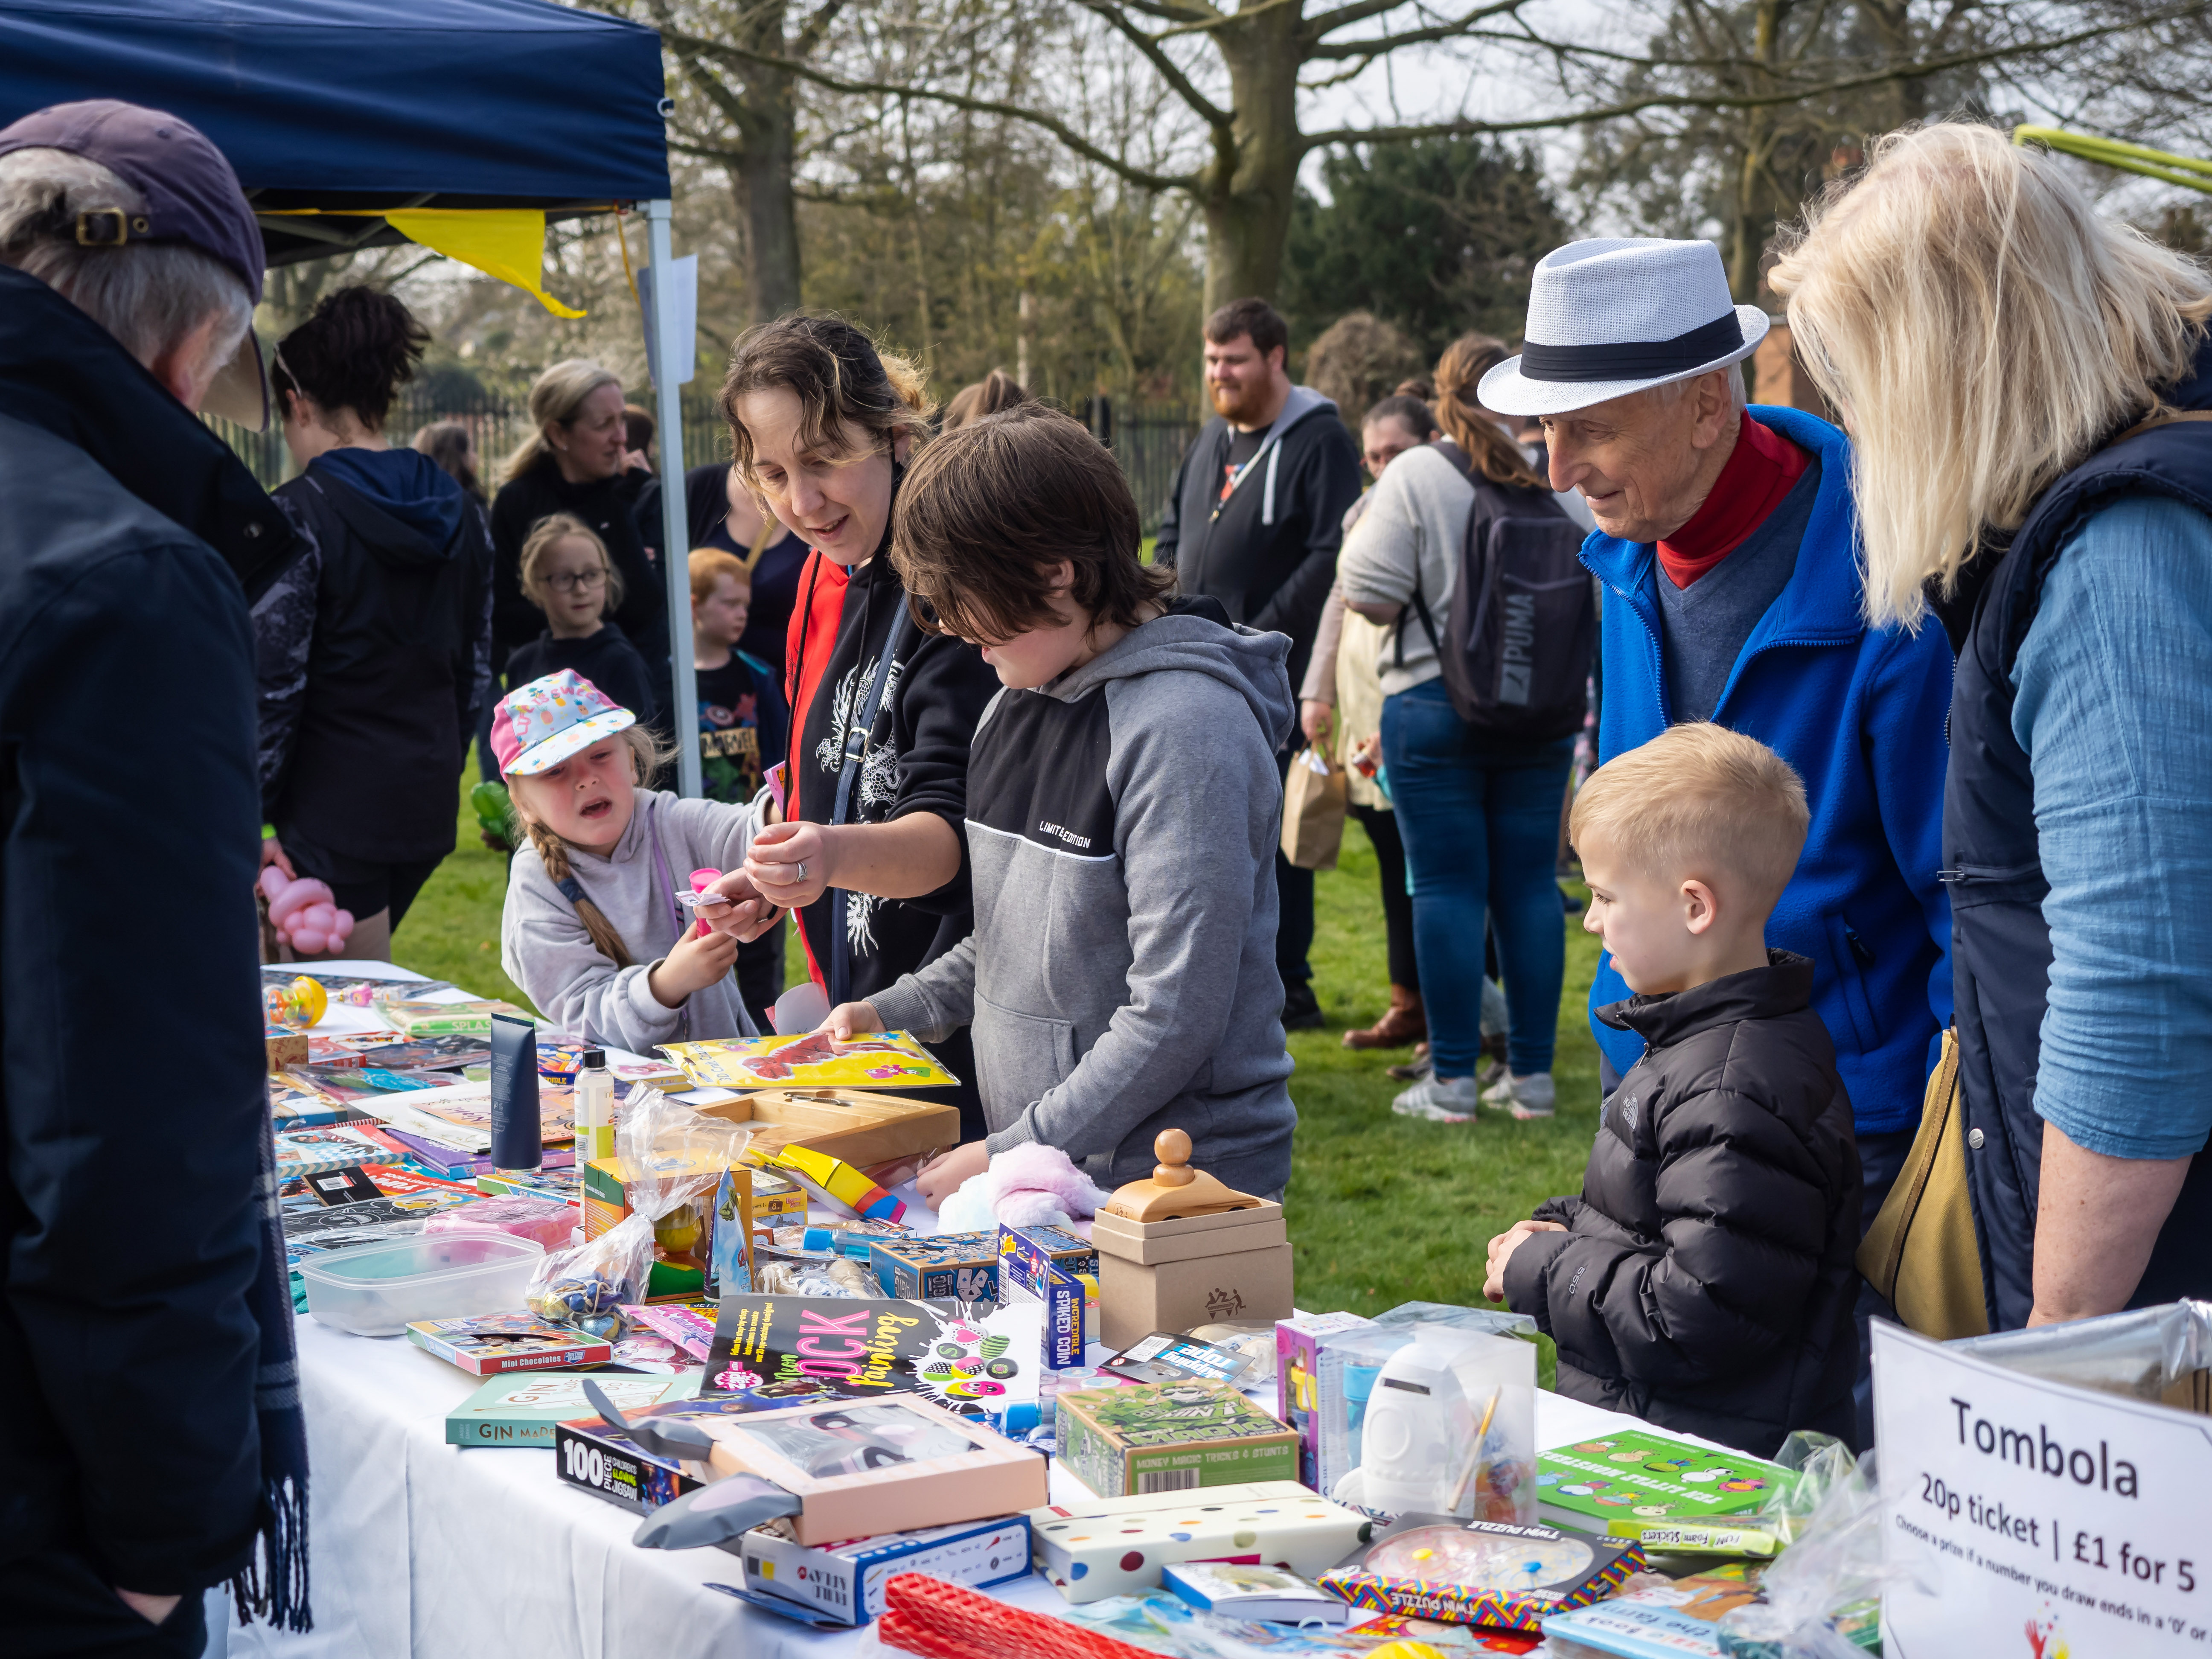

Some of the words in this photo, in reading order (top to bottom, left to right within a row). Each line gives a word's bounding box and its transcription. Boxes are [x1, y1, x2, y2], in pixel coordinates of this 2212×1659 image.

[1502, 594, 1535, 660] PUMA
[1062, 830, 1091, 848] EDITION
[452, 1021, 491, 1031] SPLAS
[542, 1157, 557, 1166] Olds
[933, 1275, 947, 1296] GIC
[1056, 1289, 1071, 1334] SPIKED
[1069, 1297, 1080, 1355] INCREDIBLE
[796, 1309, 870, 1381] OCK
[1056, 1336, 1071, 1365] COIN
[501, 1359, 518, 1368] Mini
[519, 1354, 562, 1367] Chocolates
[507, 1384, 559, 1403] GIN
[479, 1423, 513, 1441] GIN
[520, 1427, 556, 1439] MADE
[1123, 1420, 1278, 1447] MAGIC
[1136, 1455, 1170, 1469] MONEY
[1172, 1453, 1202, 1467] MAGIC
[1205, 1450, 1239, 1462] TRICKS
[1252, 1445, 1289, 1458] STUNTS
[1950, 1396, 2139, 1500] Tombola
[563, 1438, 604, 1487] 100
[604, 1454, 612, 1491] PIECE
[1536, 1449, 1627, 1478] MONSTERS
[611, 1479, 637, 1502] JIGSAW
[1620, 1472, 1687, 1494] LITTLE
[1680, 1490, 1723, 1505] TEN
[1467, 1520, 1525, 1536] PUZZLE
[1522, 1526, 1560, 1541] TWIN
[1642, 1529, 1680, 1544] Stickers
[1684, 1533, 1709, 1545] Foam
[1921, 1472, 1961, 1521] 20p
[1967, 1494, 2040, 1548] ticket
[2073, 1531, 2108, 1570] £1
[2118, 1542, 2165, 1584] for
[2177, 1560, 2195, 1593] 5
[1895, 1514, 1929, 1543] Choose
[1930, 1537, 1937, 1546] a
[1938, 1537, 1964, 1560] prize
[1966, 1547, 1974, 1563] if
[1976, 1554, 1984, 1567] a
[1985, 1555, 2032, 1586] number
[2034, 1578, 2059, 1597] you
[2061, 1583, 2096, 1608] draw
[2099, 1597, 2133, 1621] ends
[2136, 1605, 2150, 1625] in
[2154, 1616, 2164, 1629] a
[2190, 1627, 2207, 1642] or
[1390, 1592, 1439, 1612] PUZZLE
[1442, 1599, 1477, 1615] TWIN
